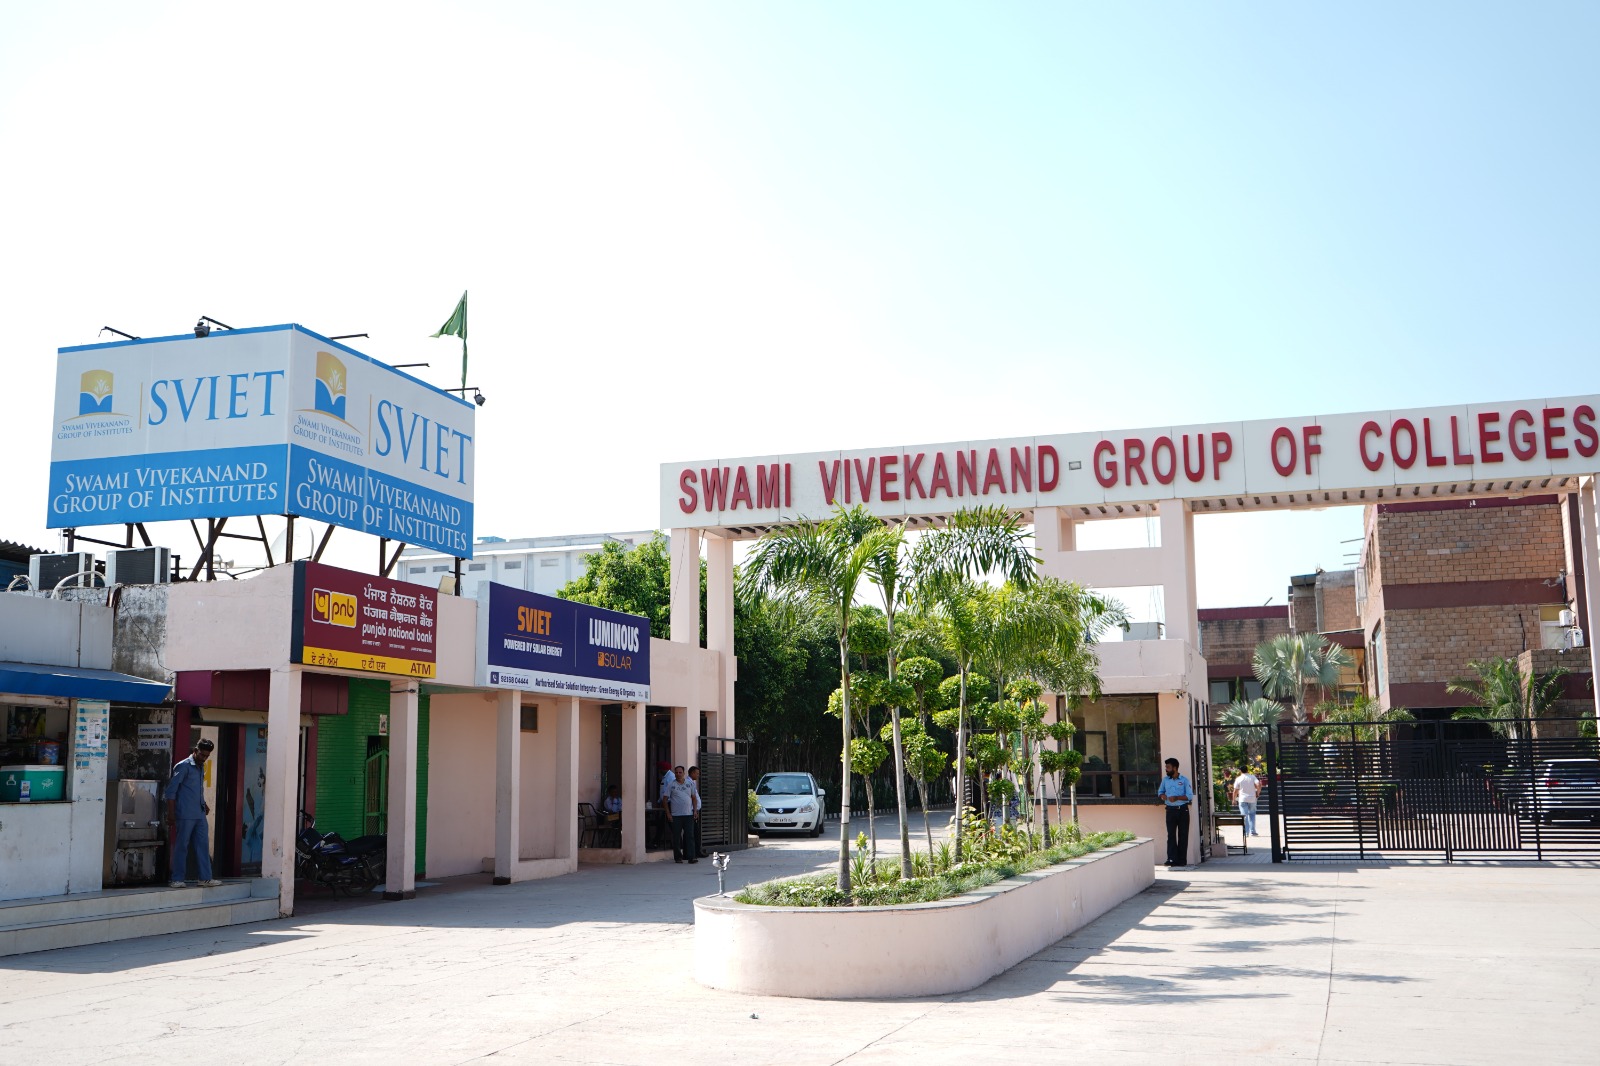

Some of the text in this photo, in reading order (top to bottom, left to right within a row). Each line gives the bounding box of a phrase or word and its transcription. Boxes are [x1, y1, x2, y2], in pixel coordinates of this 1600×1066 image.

[148, 370, 284, 425] SVIET
[85, 420, 130, 429] VIVEKANAND
[94, 427, 133, 436] INSTITUTES
[298, 415, 360, 444] SWAMI VIVEKANAND
[294, 425, 363, 456] GROUP OF INSTITUTES
[376, 400, 472, 485] SVIET
[679, 404, 1600, 514] SWAMI VIVEKANAND GROUP OF COLLEGES
[65, 462, 268, 494] SWAMI VIVEKANAND
[308, 458, 461, 526] SWAMI VIVEKANAND
[53, 482, 278, 514] GROUP OF INSTITUTES
[296, 482, 466, 551] GROUP OF INSTITUTES
[332, 598, 354, 620] pnb
[363, 604, 388, 620] पंजाब
[518, 606, 552, 635] SVIET
[362, 622, 432, 643] punjab national bank
[589, 618, 639, 653] LUMINOUS
[504, 638, 562, 657] POWERED BY SOLAR ENERGY
[604, 654, 632, 670] SOLAR
[410, 663, 431, 675] ATM
[556, 680, 565, 689] Solar
[566, 682, 579, 690] Solution
[600, 686, 608, 694] Green
[609, 687, 620, 697] Energy
